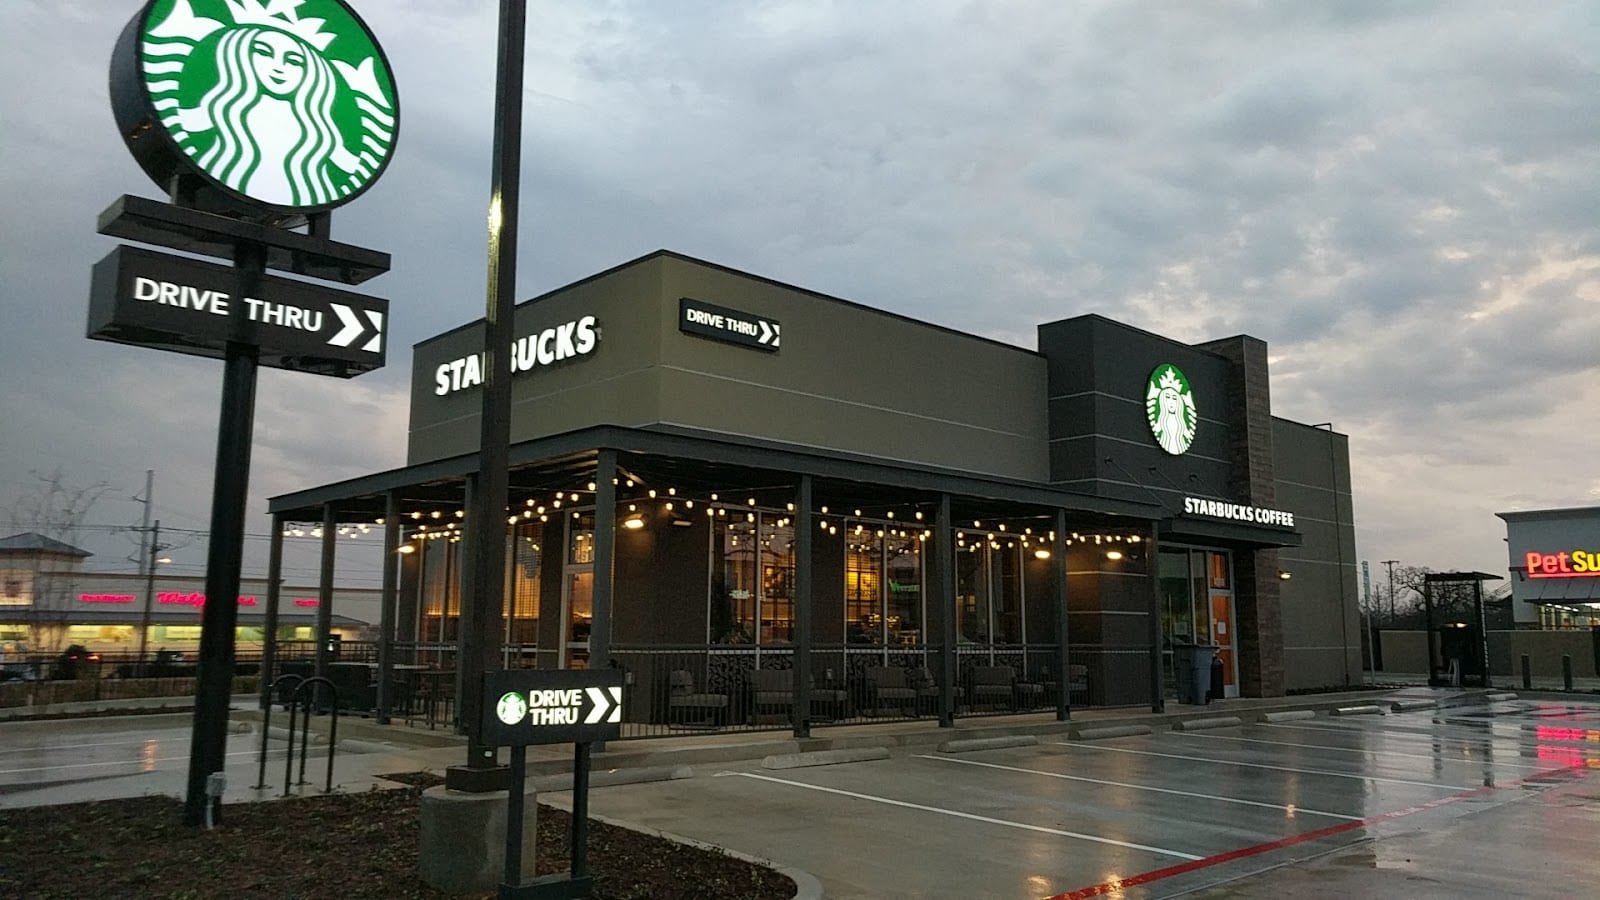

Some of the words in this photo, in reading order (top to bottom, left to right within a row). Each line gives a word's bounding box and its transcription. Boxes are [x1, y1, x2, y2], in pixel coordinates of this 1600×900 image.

[134, 277, 230, 316] DRIVE
[244, 297, 323, 332] THRU
[687, 308, 724, 329] DRIVE
[725, 317, 758, 337] THRU
[1184, 497, 1254, 522] STARBUCKS
[1255, 508, 1295, 527] COFFEE
[1526, 551, 1571, 574] Pet
[529, 688, 583, 708] DRIVE
[529, 707, 579, 726] THRU
